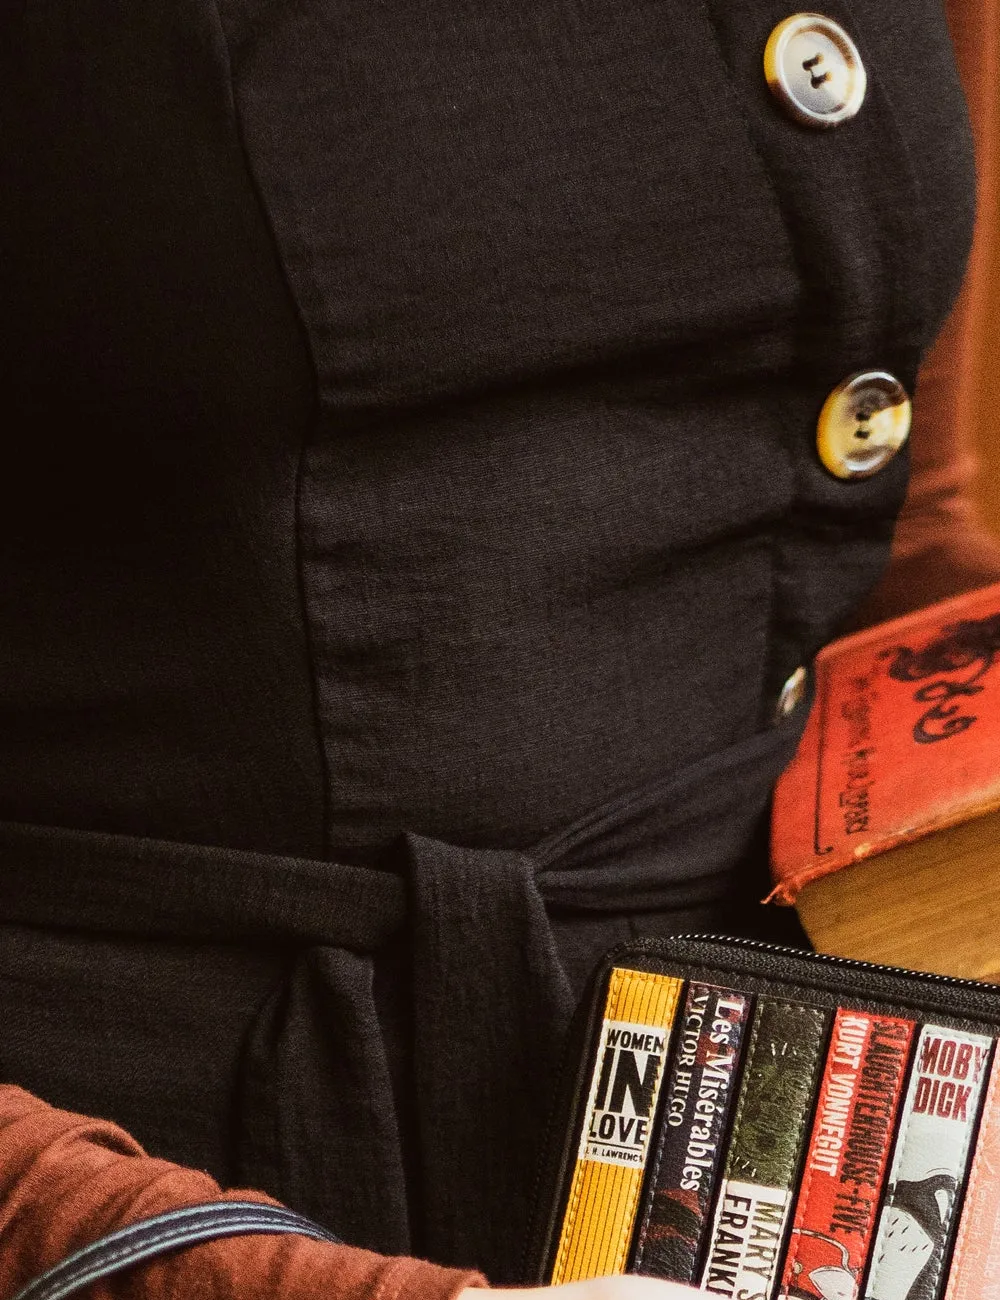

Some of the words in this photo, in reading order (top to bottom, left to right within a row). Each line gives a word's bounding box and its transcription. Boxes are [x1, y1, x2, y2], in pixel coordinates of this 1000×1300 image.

[607, 1028, 664, 1053] WOMEN
[679, 995, 709, 1066] VICTOR
[710, 998, 744, 1045] Les
[833, 1016, 869, 1070] KURT
[594, 1047, 661, 1117] IN
[919, 1036, 988, 1083] MOBY
[668, 1071, 692, 1127] HUGO
[680, 1050, 733, 1191] Misérables
[810, 1072, 857, 1177] VONNEGUT
[913, 1077, 972, 1122] DICK
[590, 1113, 648, 1145] LOVE
[829, 1020, 906, 1236] SLAUGHTERHOUSE-FIVE
[742, 1200, 785, 1280] MARY
